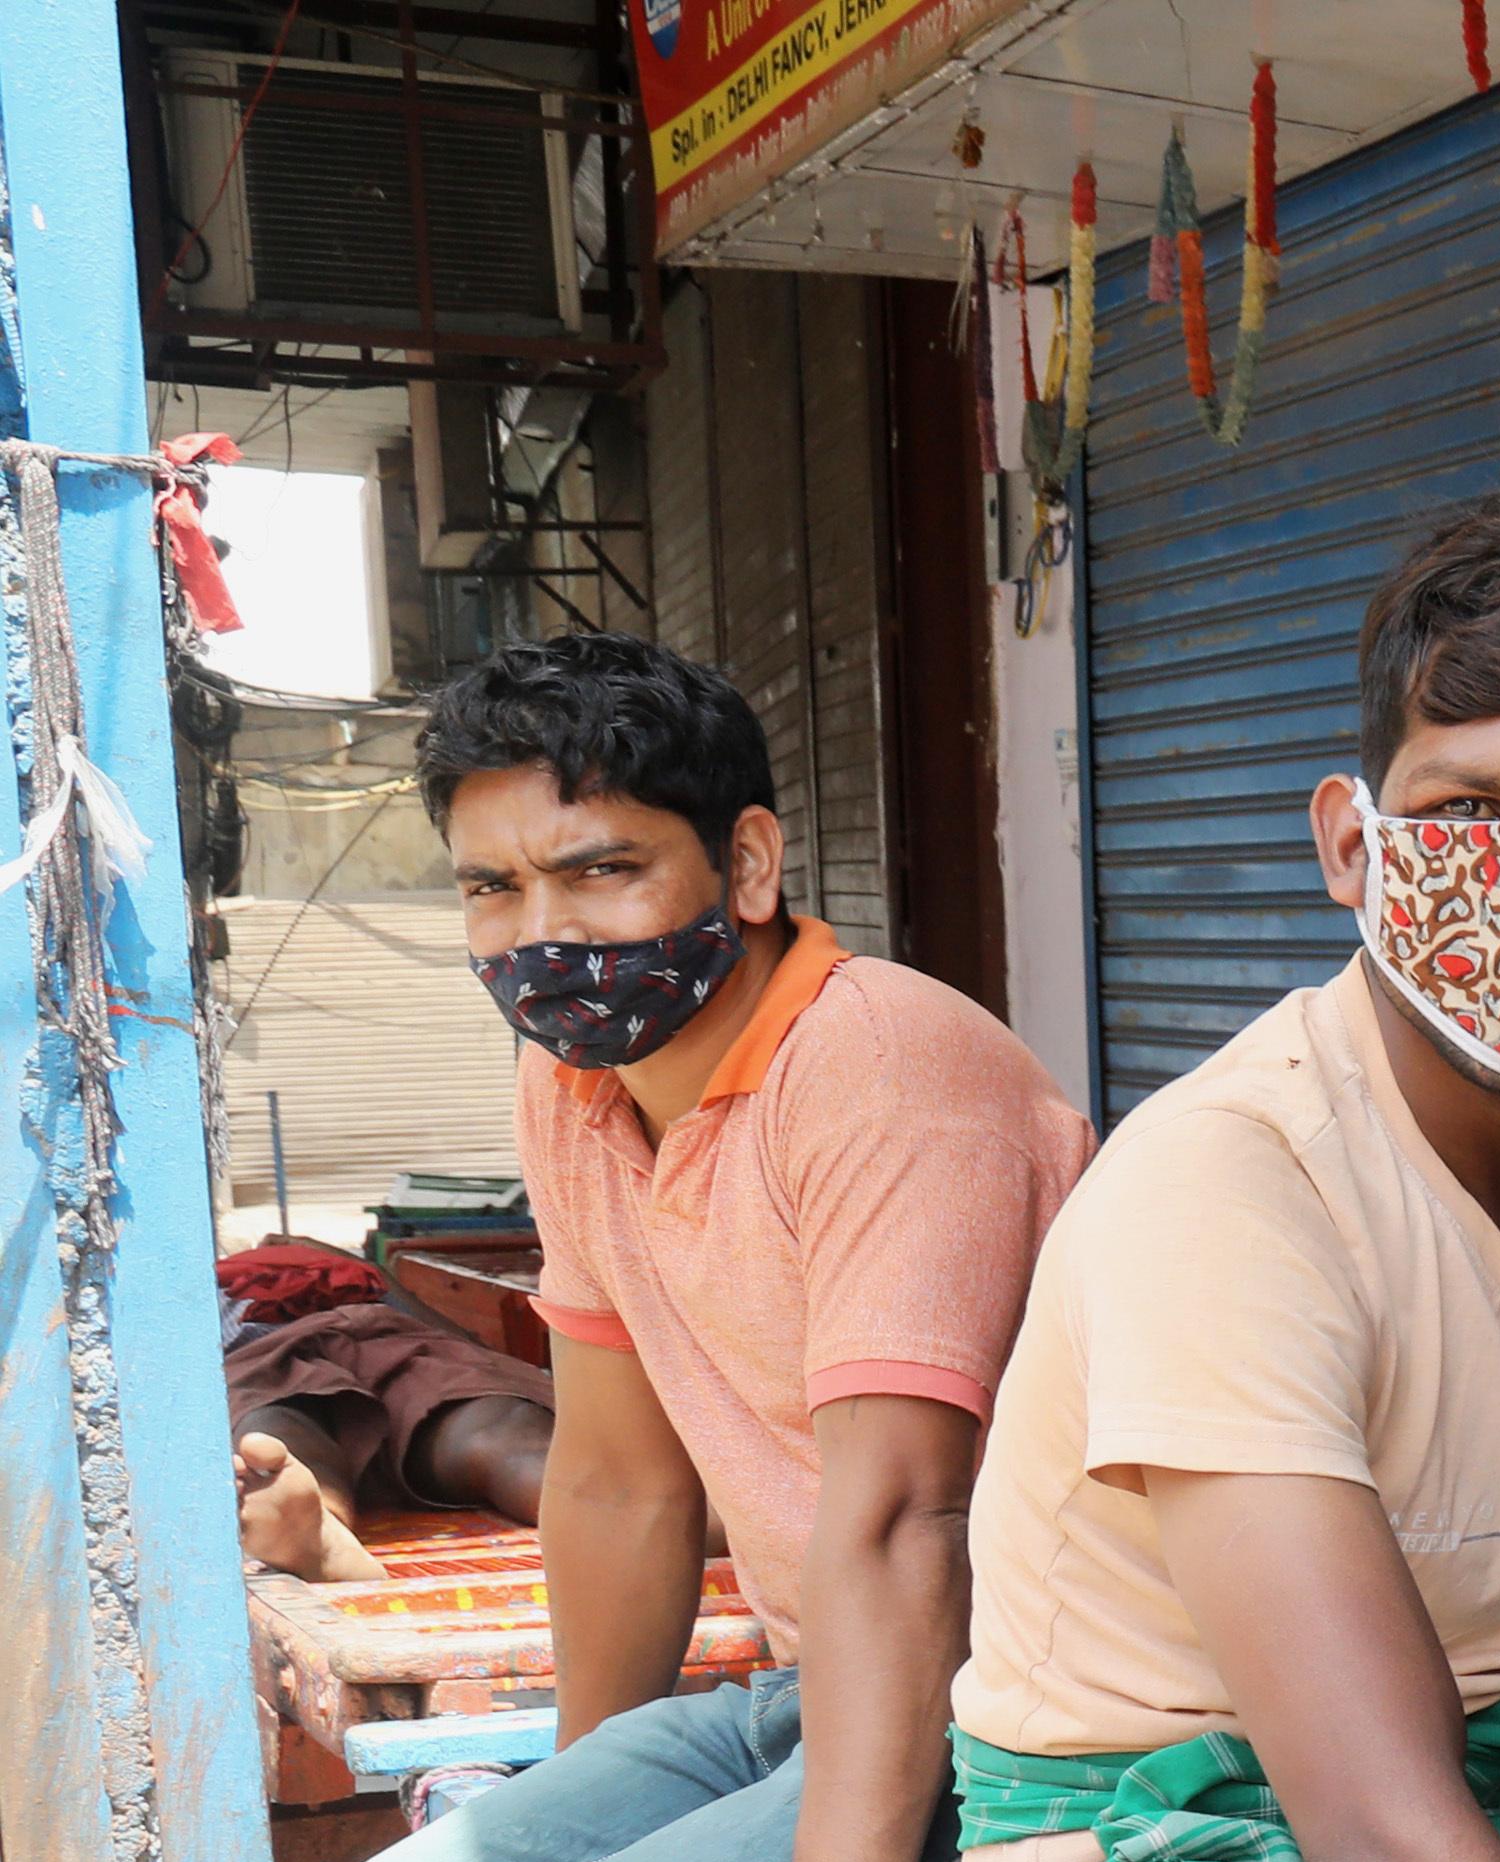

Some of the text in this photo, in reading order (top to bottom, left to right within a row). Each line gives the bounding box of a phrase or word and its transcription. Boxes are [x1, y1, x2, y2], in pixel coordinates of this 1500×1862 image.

[671, 118, 698, 166] Spl.
[702, 107, 716, 141] in
[727, 57, 769, 123] DELHI
[771, 11, 829, 87] FANCY,
